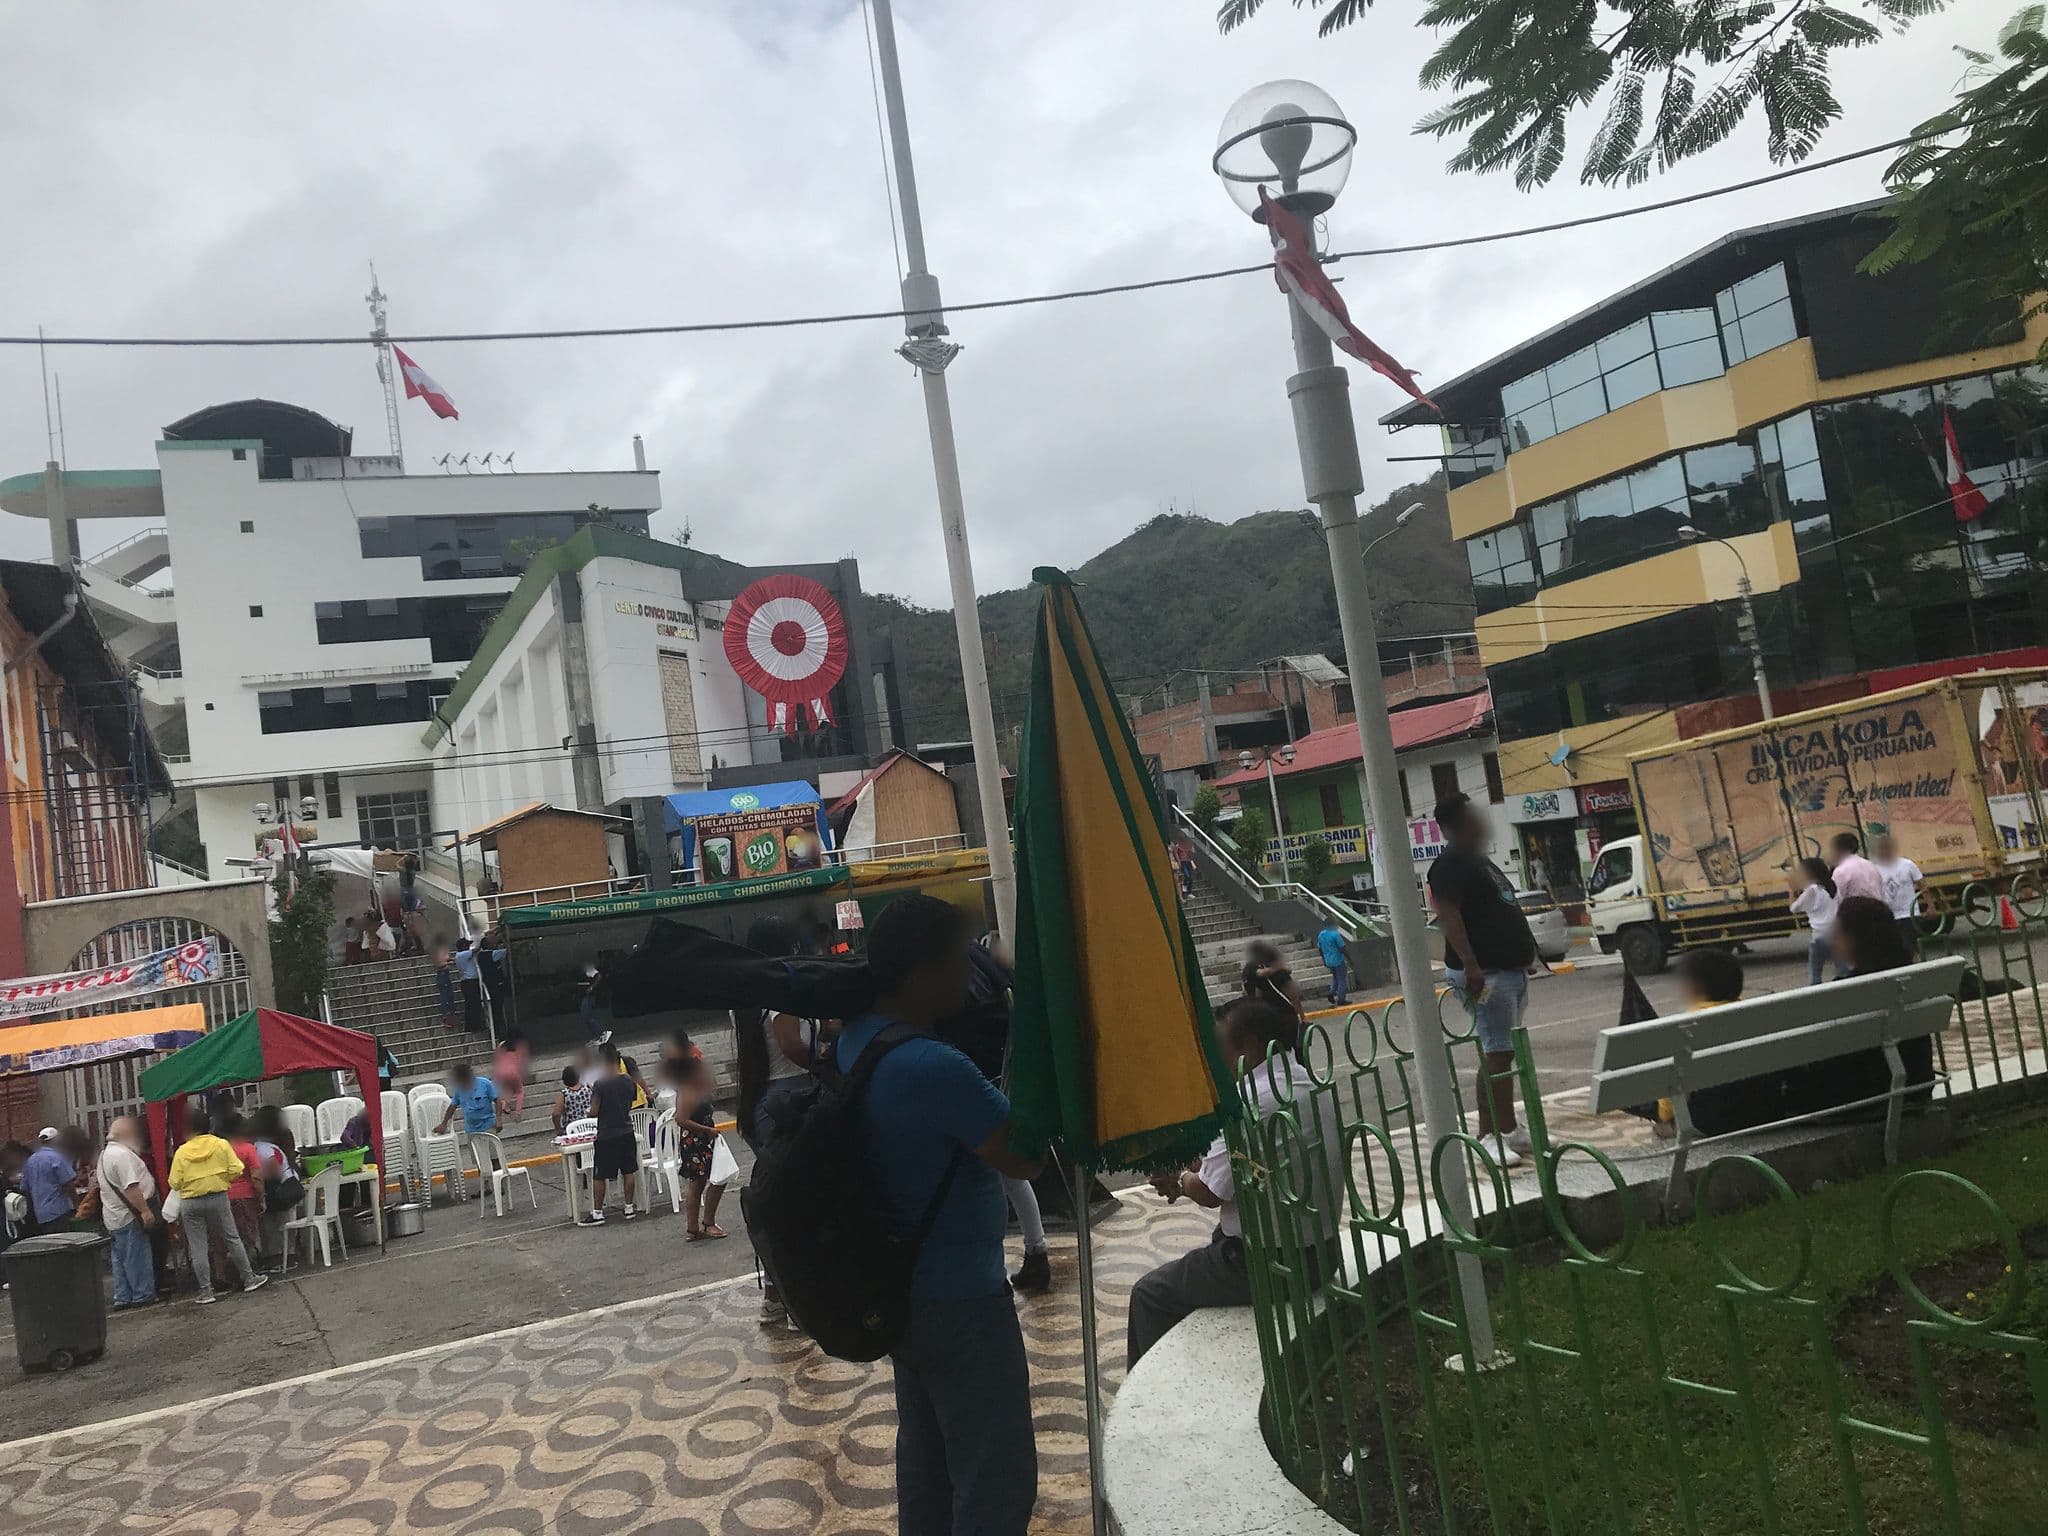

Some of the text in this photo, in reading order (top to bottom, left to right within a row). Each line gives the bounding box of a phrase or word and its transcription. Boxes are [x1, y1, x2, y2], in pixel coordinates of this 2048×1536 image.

[615, 600, 643, 617] CENTRO
[1752, 709, 1924, 766] INCA KOLA
[1854, 731, 1936, 763] PERUANA
[700, 807, 813, 828] HELADOS-CREMOLADAS
[710, 826, 727, 834] CON
[729, 822, 759, 832] FRUTAS
[550, 876, 813, 918] MUNICIPALIDAD PROVINCIAL CHANCHAMAYO
